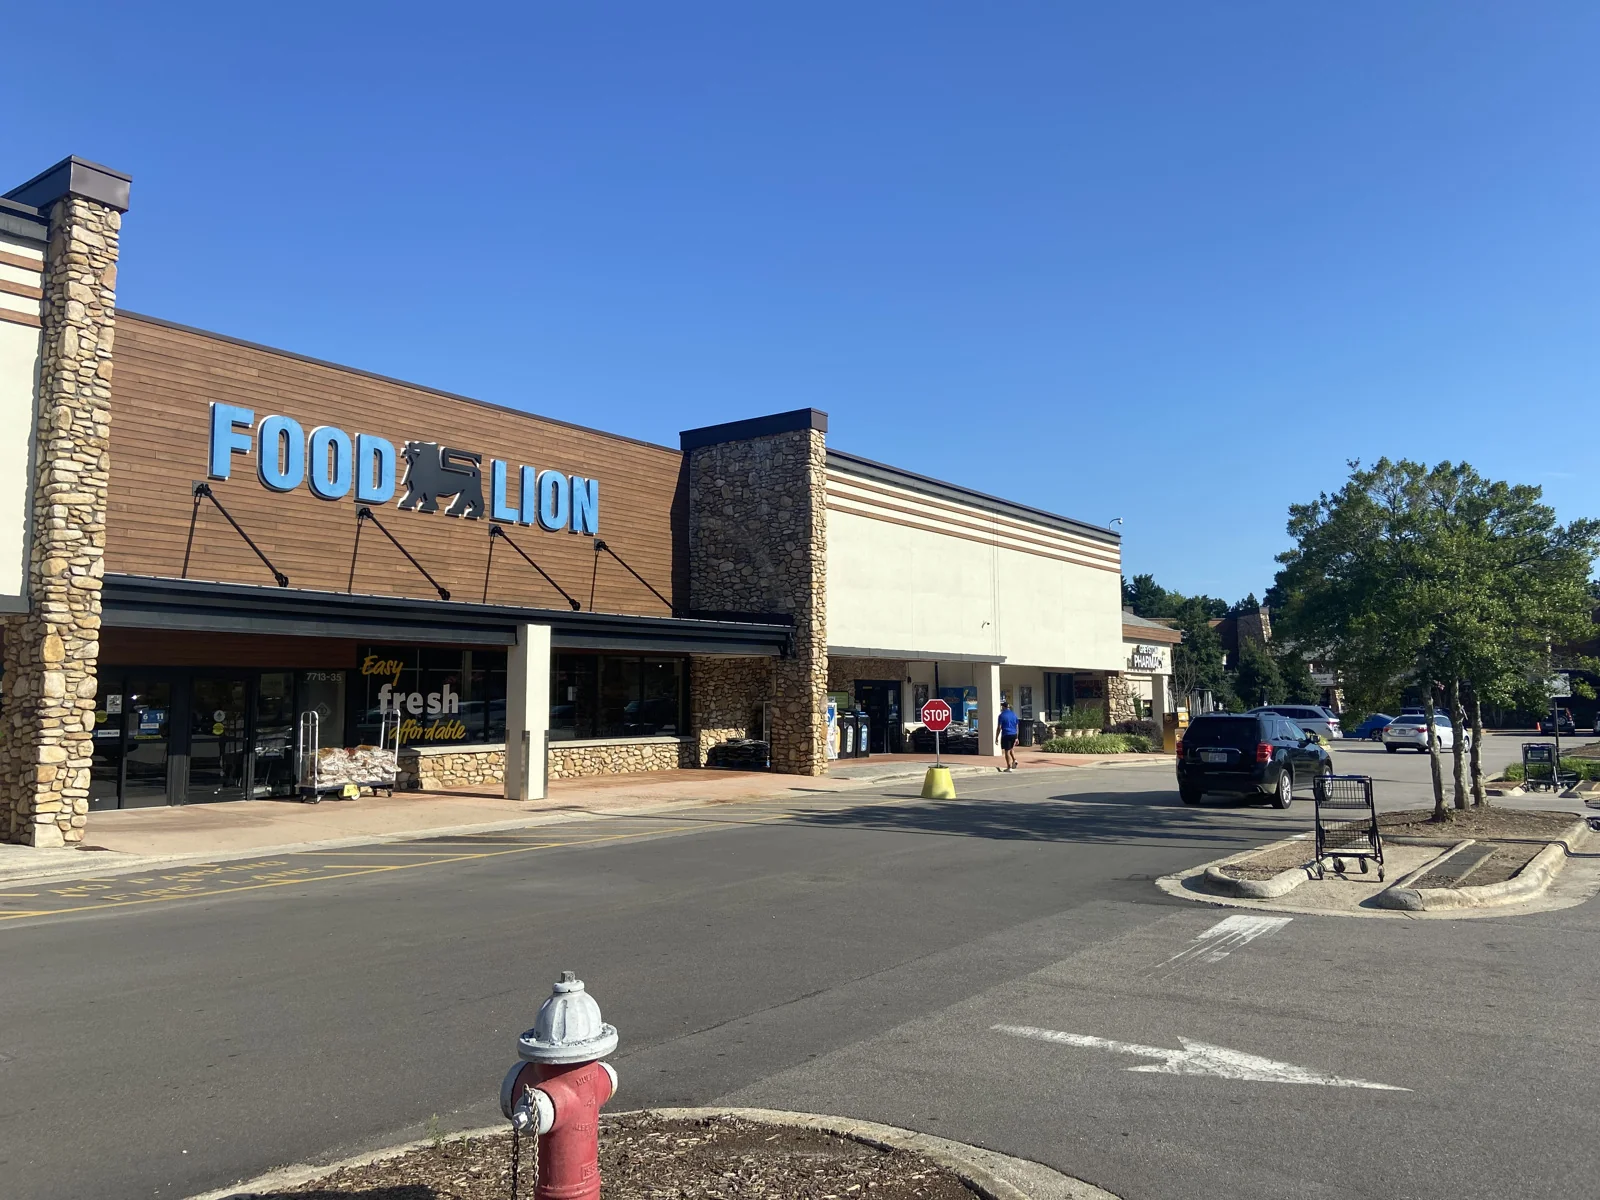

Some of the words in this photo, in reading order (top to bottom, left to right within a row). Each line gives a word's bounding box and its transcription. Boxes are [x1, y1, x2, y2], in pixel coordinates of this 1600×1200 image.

[207, 401, 396, 505] FOOD
[489, 458, 600, 536] LION
[306, 672, 342, 682] 7713-35
[361, 655, 404, 686] Easy
[378, 683, 459, 715] fresh
[923, 709, 950, 722] STOP
[388, 719, 467, 744] affordable
[49, 883, 112, 896] NO
[128, 860, 289, 885] PARKING
[101, 884, 207, 900] FIRE
[220, 866, 325, 884] LANE
